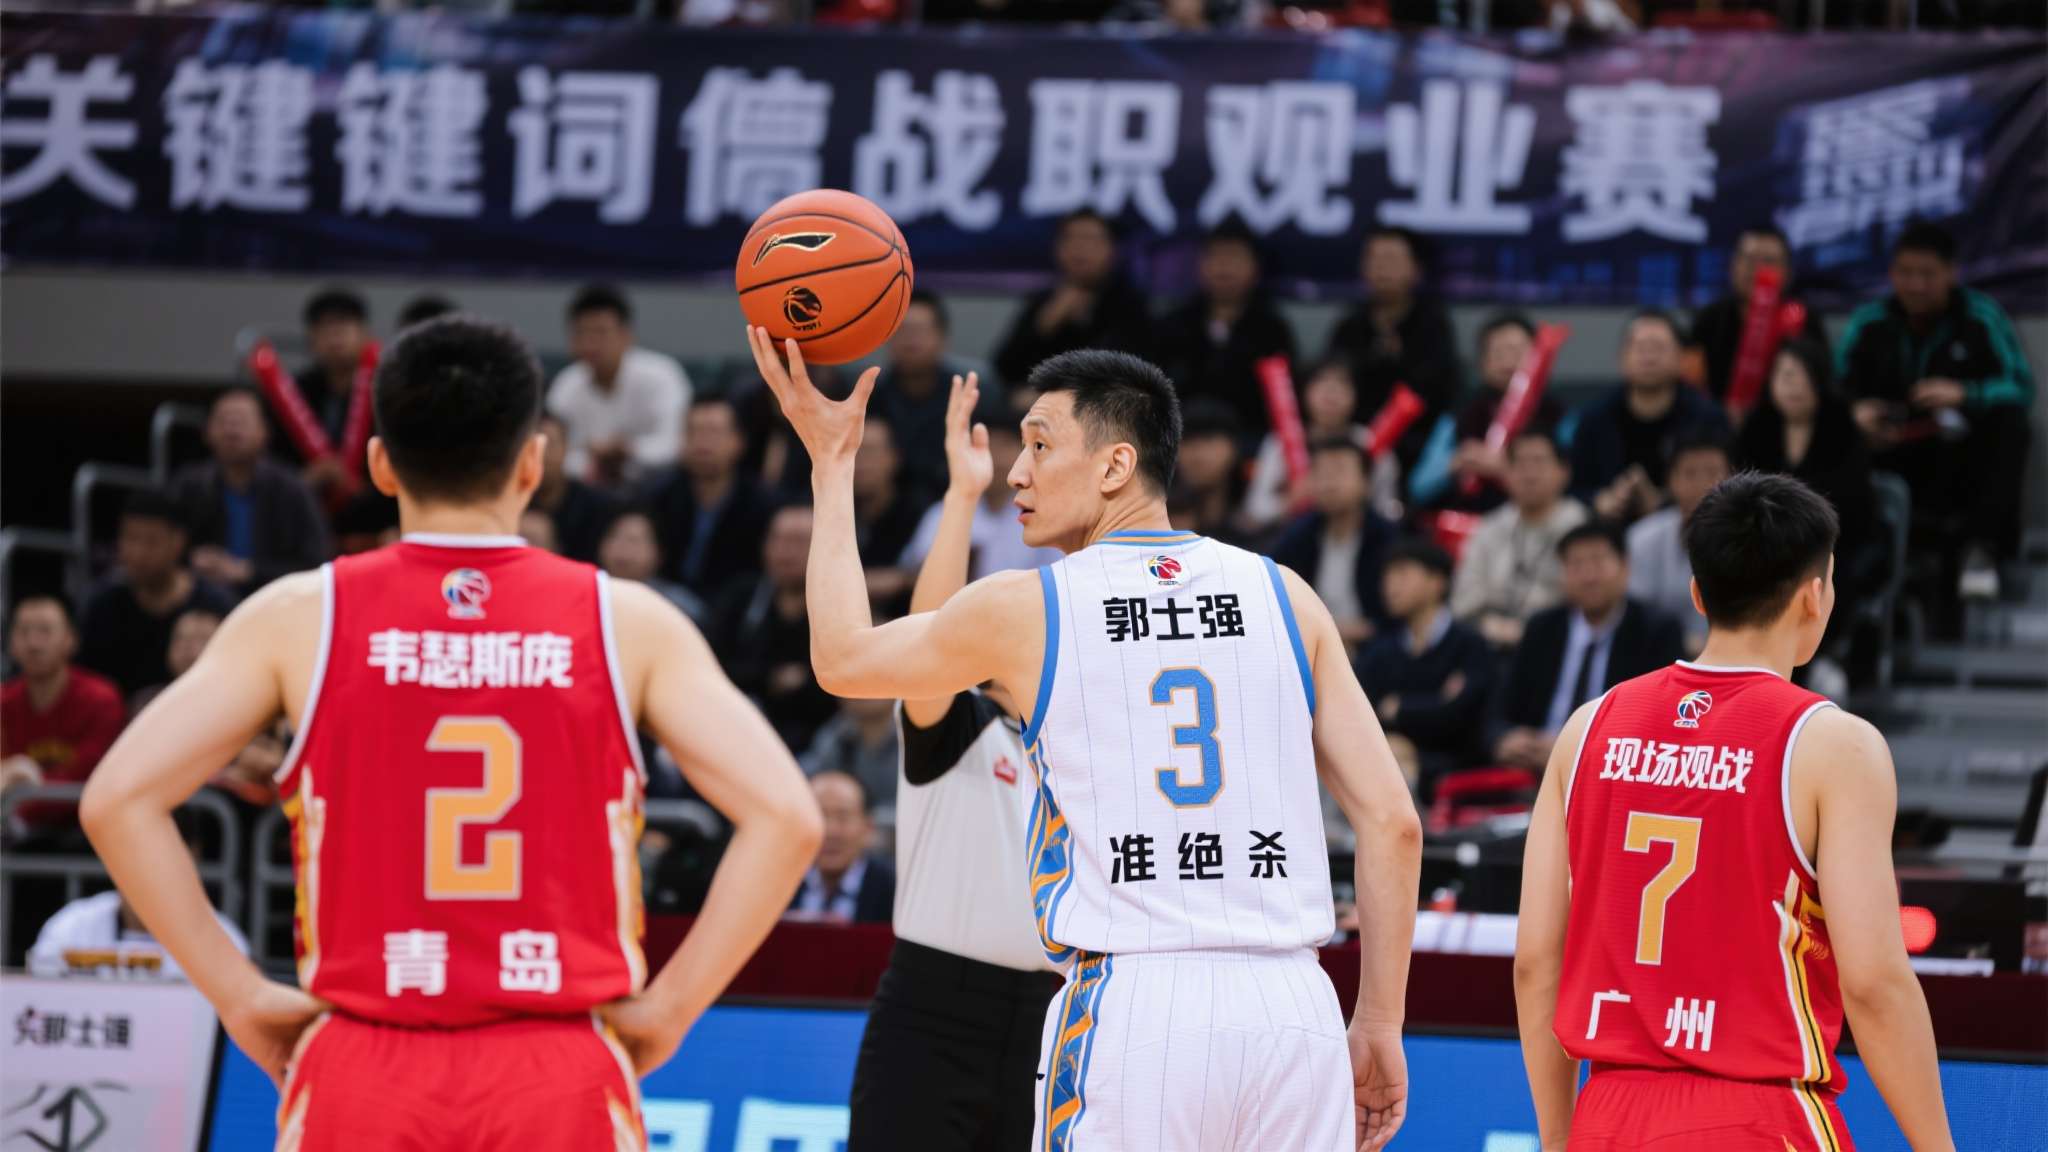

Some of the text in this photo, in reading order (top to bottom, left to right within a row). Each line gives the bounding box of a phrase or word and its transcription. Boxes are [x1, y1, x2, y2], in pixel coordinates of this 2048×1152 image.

[1103, 594, 1245, 642] 郭士强
[1149, 666, 1226, 809] 3
[1600, 738, 1753, 793] 现场观战
[424, 715, 522, 900] 2
[1110, 830, 1288, 884] 准绝杀
[1624, 811, 1702, 965] 7
[383, 929, 562, 996] 青岛
[1586, 990, 1715, 1051] 广州
